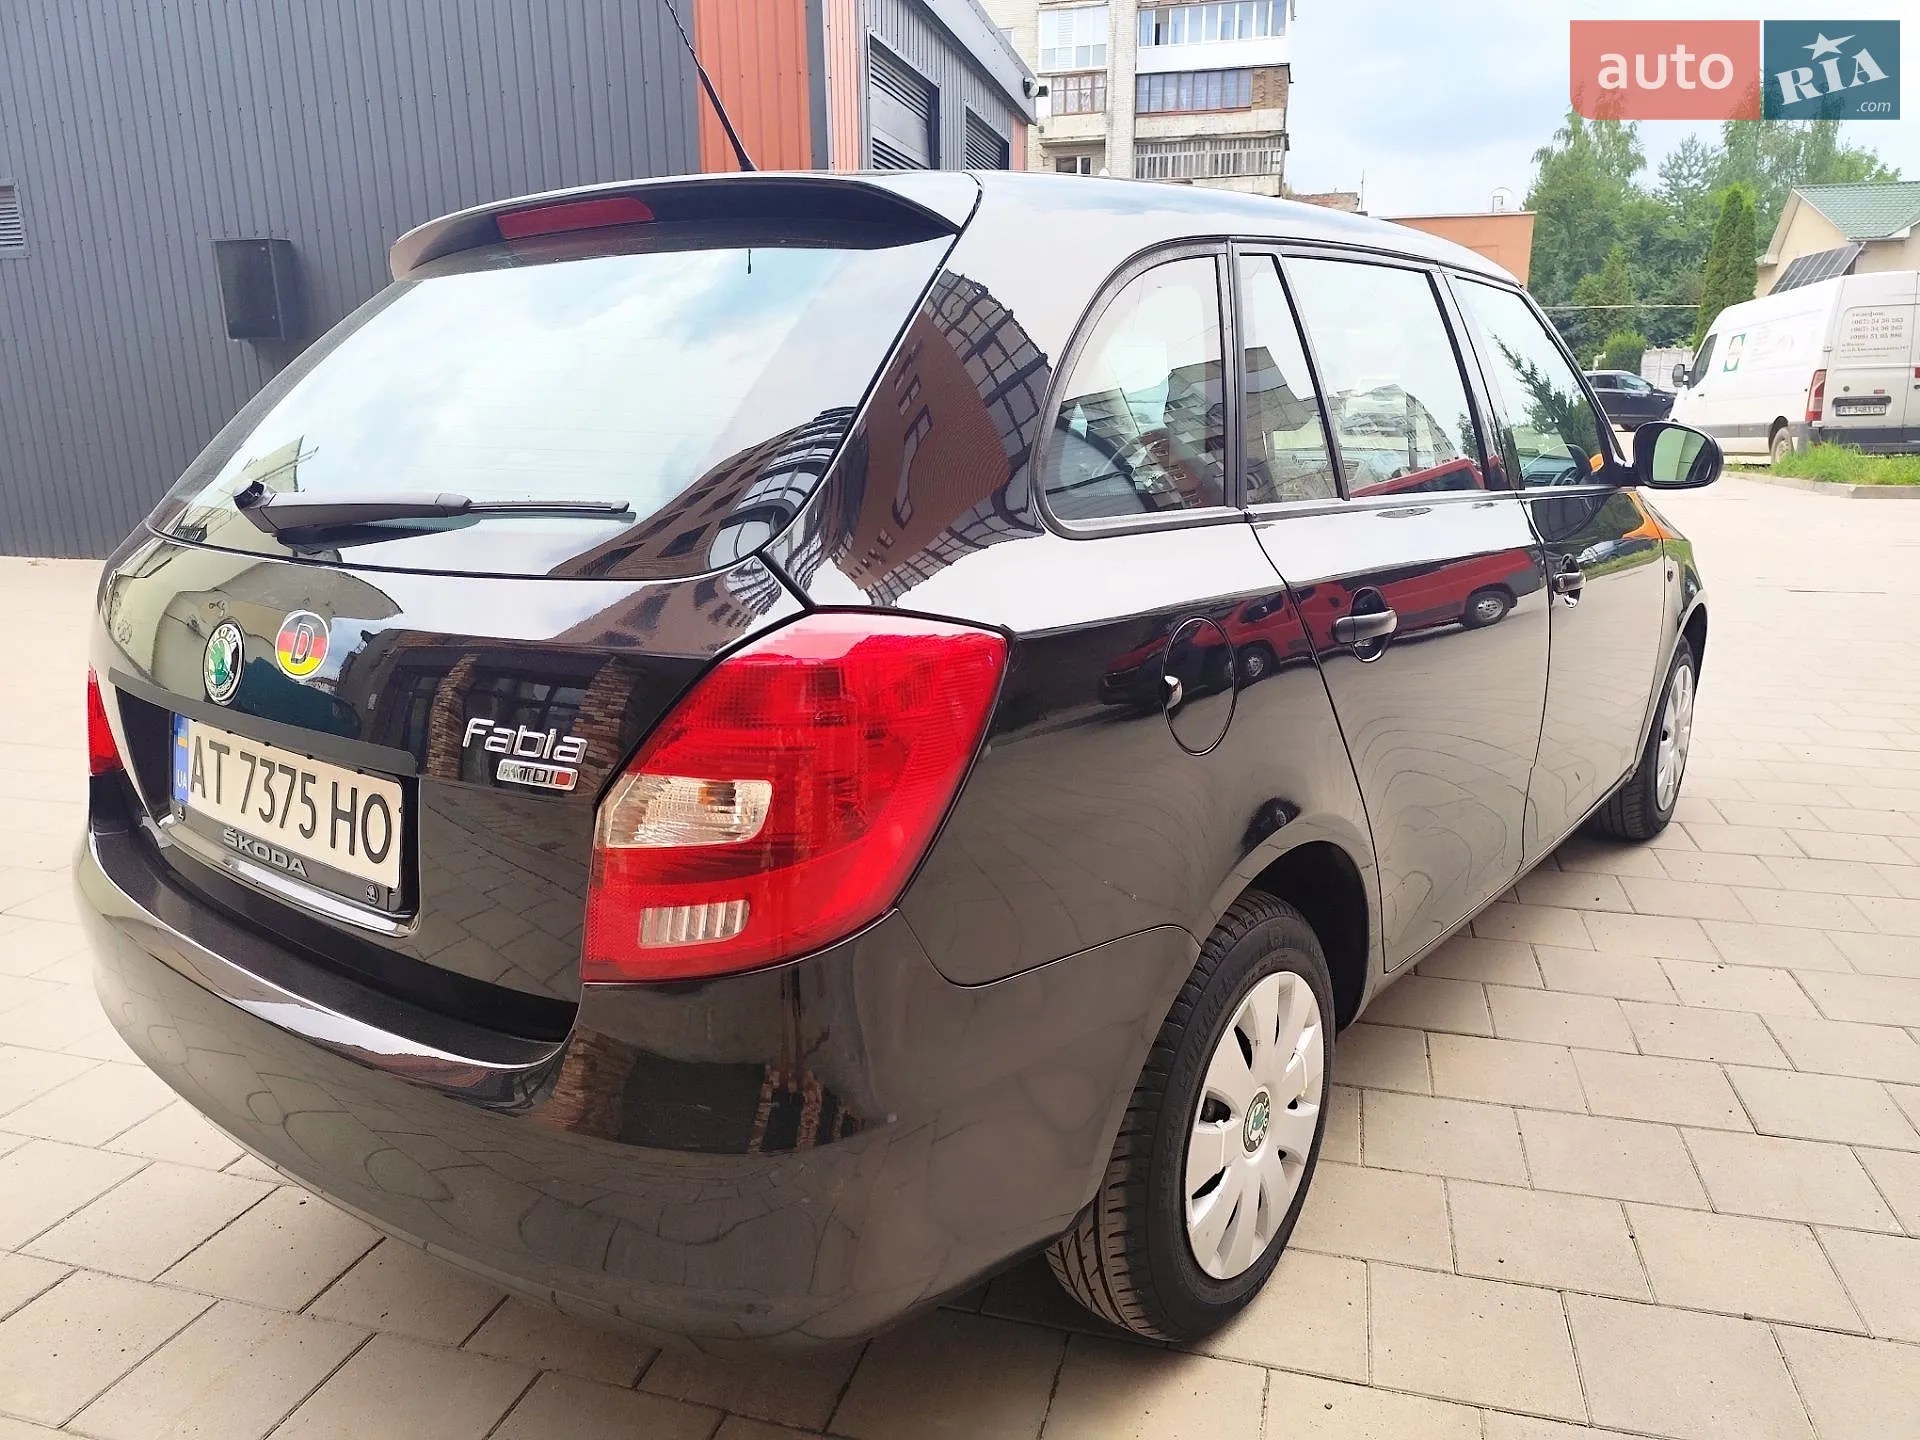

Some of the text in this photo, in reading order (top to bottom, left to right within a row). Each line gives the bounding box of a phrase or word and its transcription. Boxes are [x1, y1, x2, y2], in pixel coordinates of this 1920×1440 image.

[290, 622, 314, 665] D
[462, 717, 588, 764] Fabia
[177, 768, 188, 791] UA
[190, 735, 392, 864] AT 7375 HO
[223, 827, 309, 878] ŠKODA
